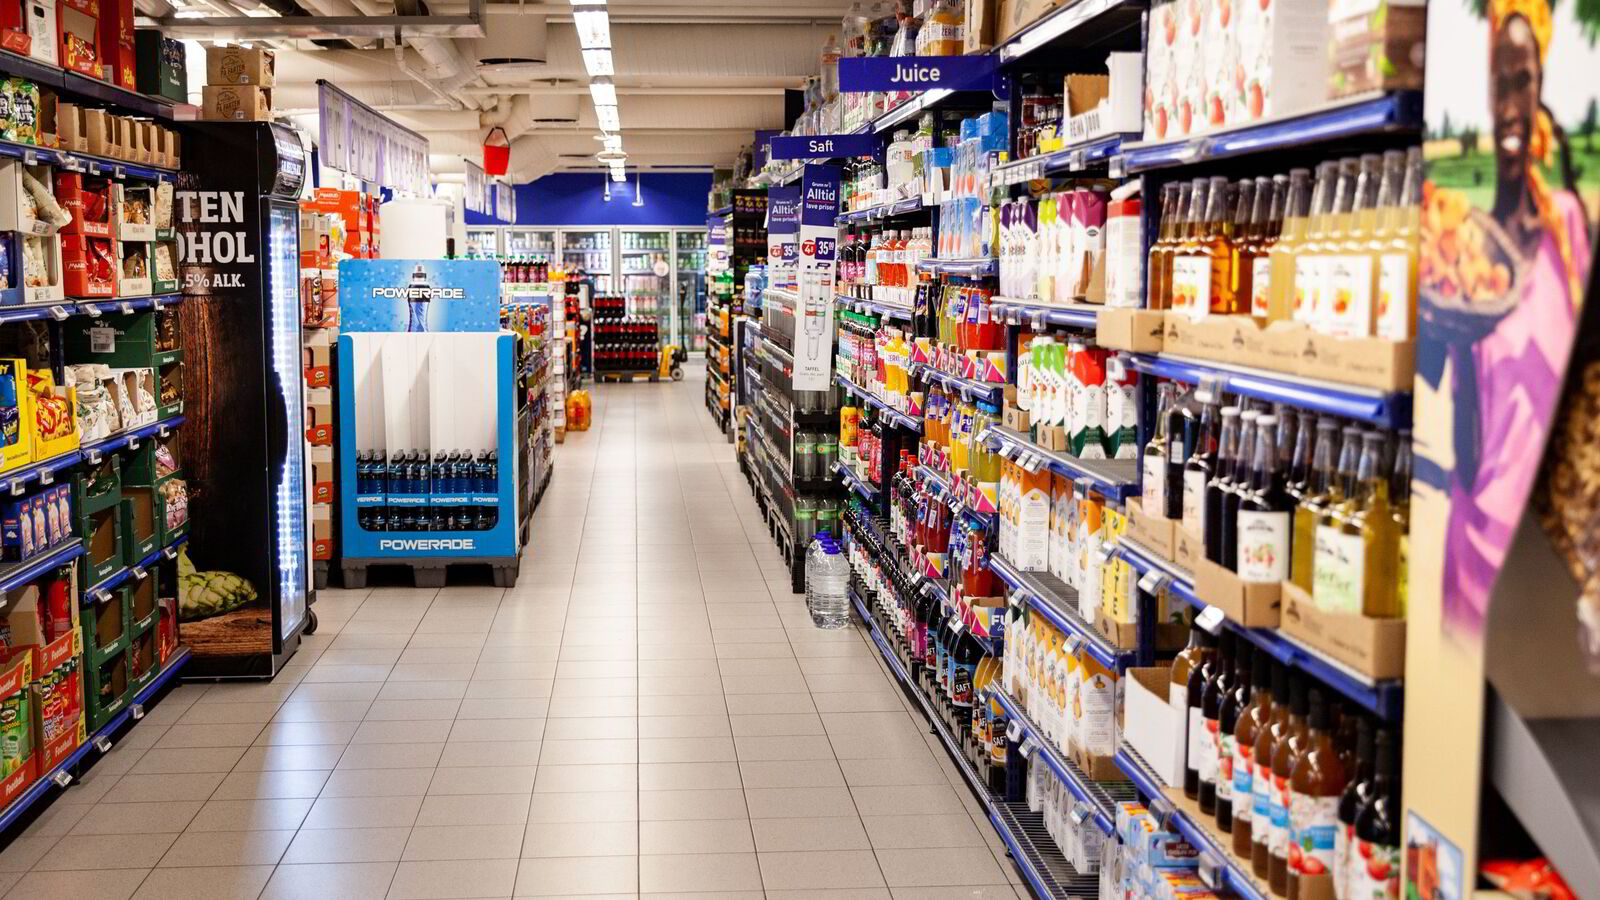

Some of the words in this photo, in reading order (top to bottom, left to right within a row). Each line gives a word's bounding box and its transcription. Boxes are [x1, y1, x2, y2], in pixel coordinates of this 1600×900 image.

[890, 64, 941, 83] Juice
[809, 140, 834, 153] Saft
[807, 188, 836, 200] Alltid
[212, 273, 245, 288] ALK.
[372, 287, 465, 299] POWERADE
[380, 538, 474, 551] POWERADE
[955, 682, 971, 693] SAFT
